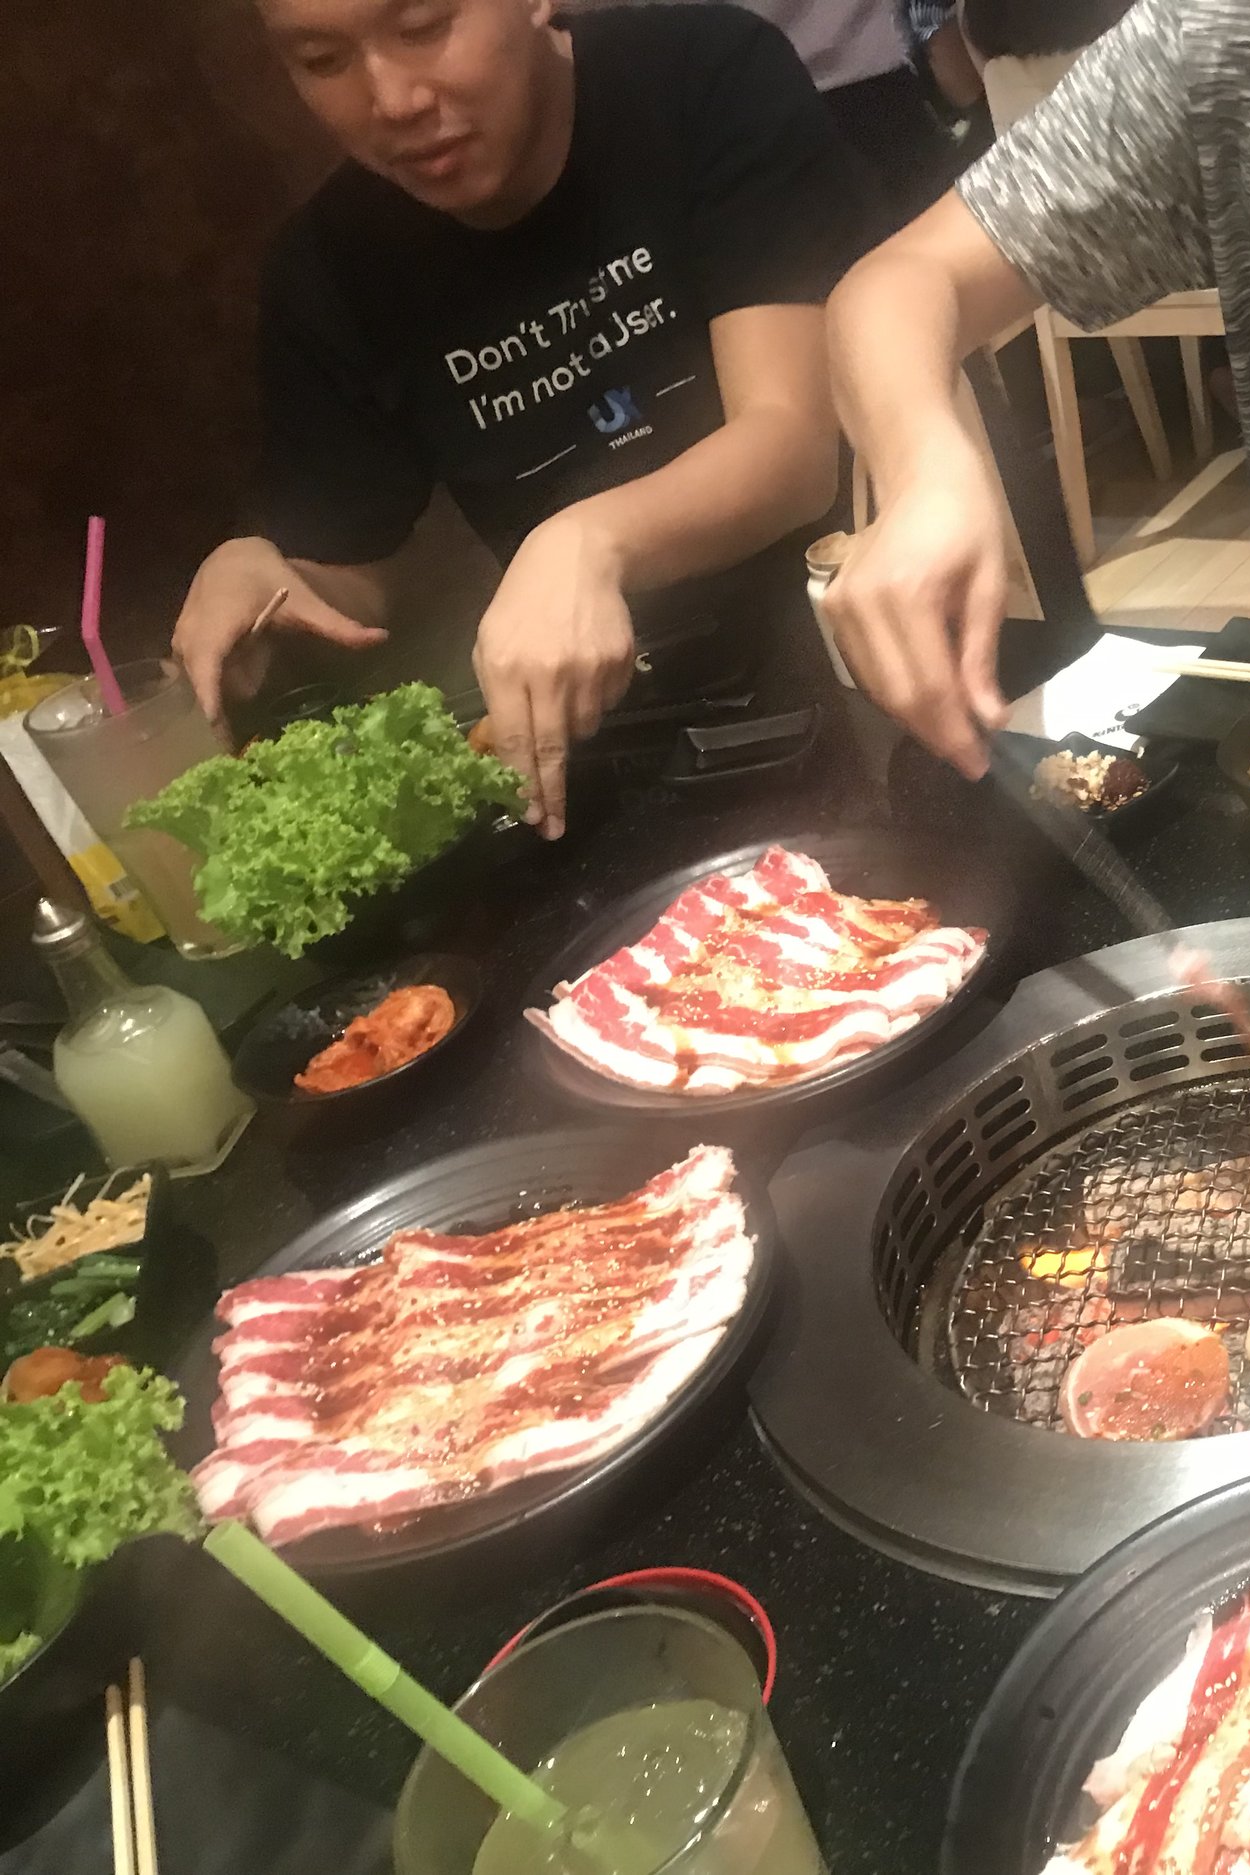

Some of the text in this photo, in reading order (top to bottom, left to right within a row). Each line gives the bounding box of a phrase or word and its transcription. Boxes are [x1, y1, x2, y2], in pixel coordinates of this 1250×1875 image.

[445, 320, 550, 384] Don't
[469, 393, 525, 430] I'm
[532, 352, 591, 403] not
[589, 332, 612, 359] a
[609, 425, 653, 450] THAILAND
